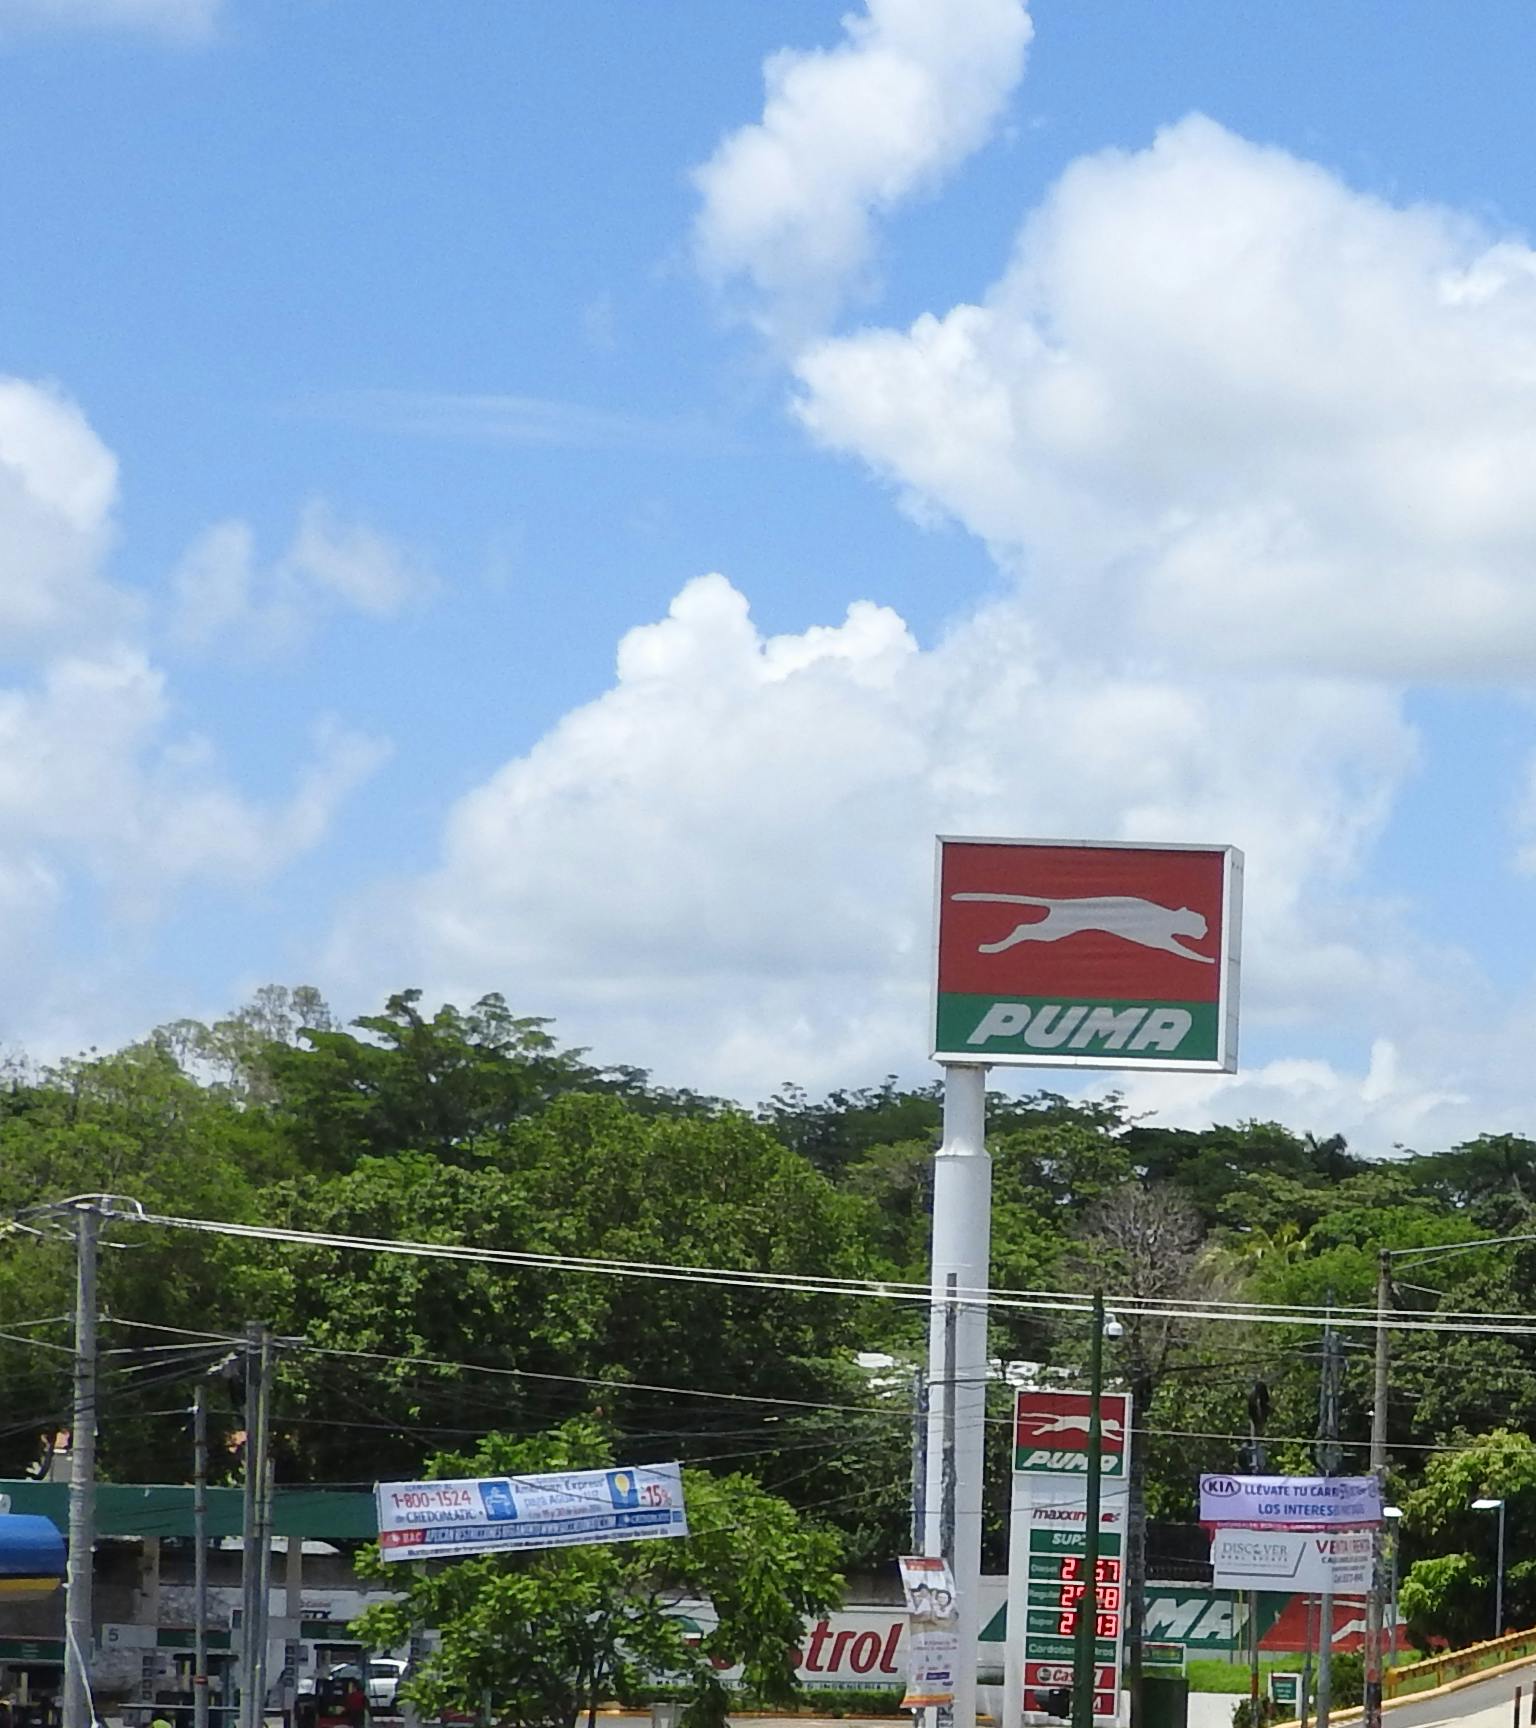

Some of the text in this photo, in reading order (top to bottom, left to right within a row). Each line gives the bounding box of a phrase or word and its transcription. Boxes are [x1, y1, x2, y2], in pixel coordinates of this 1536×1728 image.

[965, 1002, 1193, 1051] PUMA
[1208, 1480, 1237, 1494] KIA
[1244, 1483, 1290, 1496] LLÉVATE
[1293, 1486, 1308, 1496] TU
[391, 1489, 472, 1509] 1-800-1524
[1032, 1508, 1087, 1522] maxxim
[1258, 1504, 1281, 1515] LOS
[1051, 1533, 1087, 1545] SUP
[108, 1627, 120, 1642] 5
